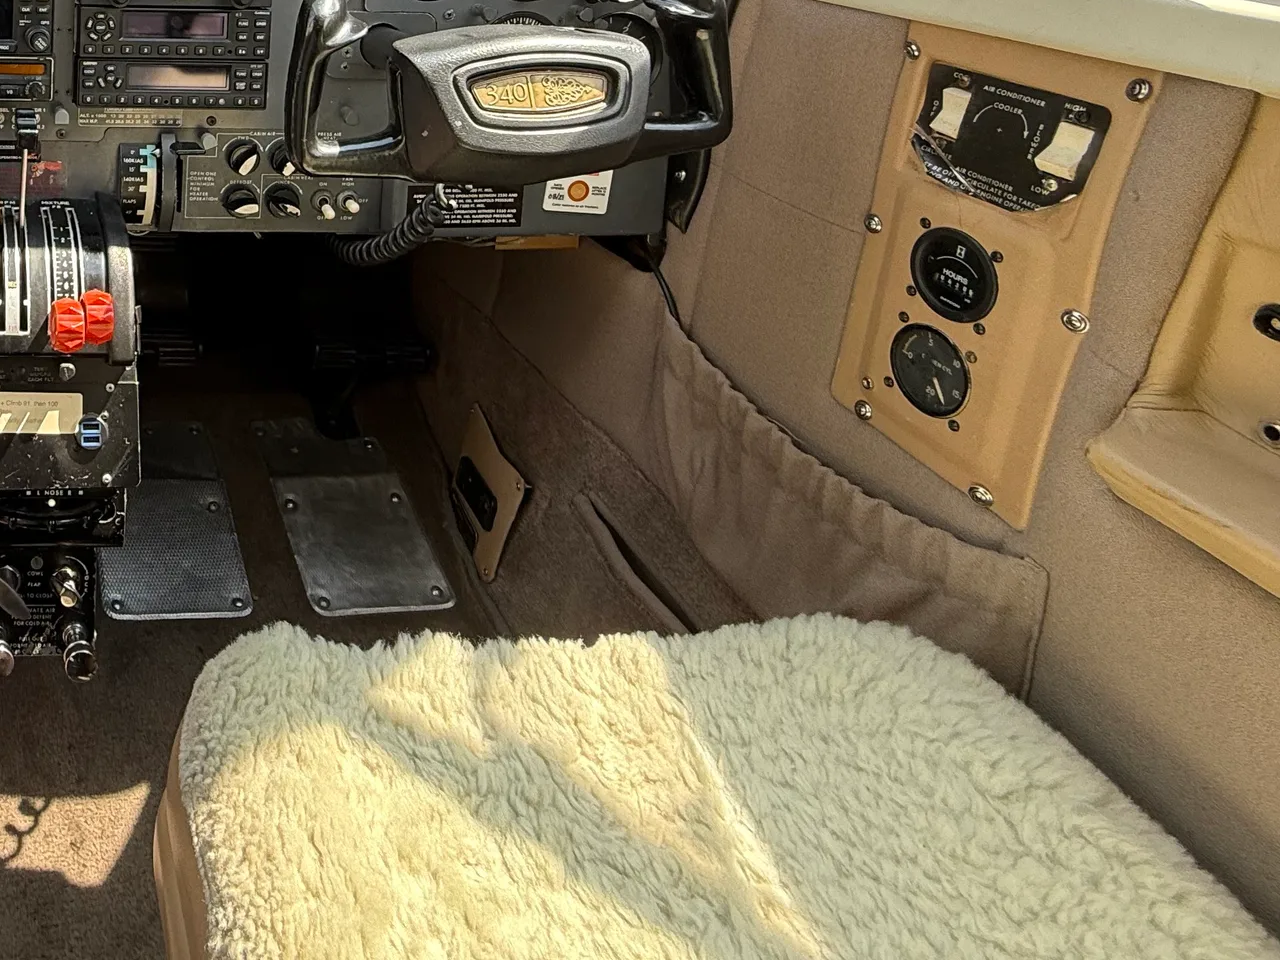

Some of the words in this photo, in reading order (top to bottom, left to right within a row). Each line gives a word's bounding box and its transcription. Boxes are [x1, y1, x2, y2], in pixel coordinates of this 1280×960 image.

[486, 81, 529, 106] 340
[983, 85, 995, 94] AIR
[996, 88, 1046, 108] CONDITIONER
[993, 102, 1023, 115] COOLER
[968, 170, 1014, 192] CONDITIONER
[1003, 190, 1018, 200] FOR
[1030, 185, 1050, 196] LOW
[942, 268, 968, 286] HOURS
[952, 359, 961, 368] 10
[925, 386, 935, 396] 20
